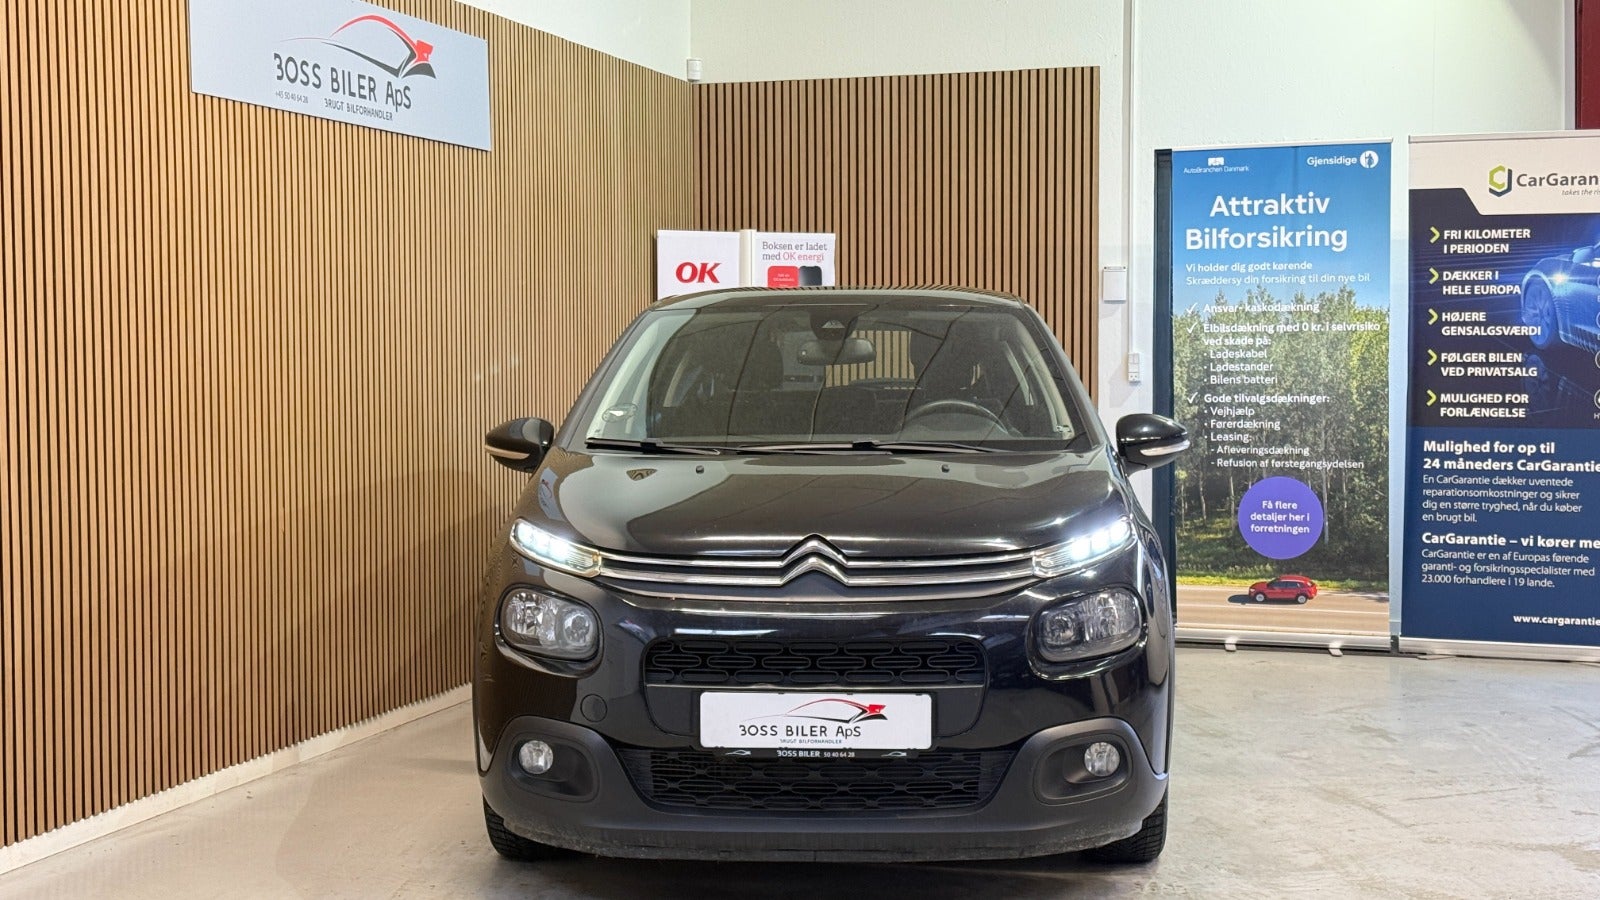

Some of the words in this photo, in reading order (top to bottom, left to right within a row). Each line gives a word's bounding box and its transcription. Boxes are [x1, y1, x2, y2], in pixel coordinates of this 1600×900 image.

[331, 67, 376, 102] BILER
[386, 81, 411, 112] ApS
[346, 102, 393, 120] BILFORHANDLER
[1307, 156, 1357, 167] Gjensidige
[1517, 173, 1600, 187] CarGaran
[1210, 191, 1330, 217] Attraktiv
[1186, 224, 1347, 252] Bilforsikring
[1443, 230, 1461, 240] FRI
[1464, 229, 1531, 239] KILOMETER
[762, 241, 793, 250] Boksen
[806, 243, 827, 251] ladet
[1444, 245, 1447, 254] I
[1450, 244, 1509, 253] PERIODEN
[762, 252, 781, 261] med
[783, 253, 796, 261] OK
[797, 253, 824, 263] energi
[675, 261, 721, 284] OK
[1186, 263, 1195, 271] Vi
[1198, 263, 1228, 271] holder
[1231, 262, 1246, 273] dig
[1248, 262, 1270, 272] godt
[1272, 261, 1312, 270] kørende
[1186, 276, 1242, 286] Skræddersy
[1244, 275, 1258, 284] din
[1261, 274, 1306, 285] forsikring
[1308, 275, 1318, 283] til
[1321, 274, 1335, 282] din
[1338, 275, 1355, 284] nye
[1358, 273, 1370, 282] bil
[1443, 271, 1492, 280] DÆKKER
[1495, 271, 1499, 280] I
[1443, 285, 1471, 295] HELE
[1474, 285, 1521, 295] EUROPA
[1245, 303, 1319, 314] kaskodækning
[1442, 312, 1486, 321] HØJERE
[1203, 323, 1274, 334] Elbilsdækning
[1277, 323, 1299, 332] med
[1302, 323, 1309, 331] 0
[1311, 323, 1324, 331] kr.
[1332, 322, 1380, 331] selvrisiko
[1441, 326, 1541, 336] GENSALGSVÆRDI
[1203, 338, 1222, 346] ved
[1224, 337, 1253, 345] skade
[1256, 336, 1271, 348] på:
[1210, 350, 1267, 358] Ladeskabel
[1441, 353, 1486, 362] FØLGER
[1488, 353, 1522, 362] BILEN
[1210, 363, 1273, 371] Ladestander
[1441, 367, 1465, 376] VED
[1467, 367, 1538, 376] PRIVATSALG
[1210, 375, 1241, 384] Bilens
[1244, 376, 1278, 384] batteri
[1204, 394, 1231, 403] Gode
[1234, 394, 1329, 404] tilvalgsdækninger:
[1440, 394, 1503, 403] MULIGHED
[1505, 394, 1529, 403] FOR
[1210, 407, 1255, 417] Vejhjælp
[1440, 408, 1526, 418] FORLÆNGELSE
[1210, 420, 1280, 430] Førerdækning
[1216, 446, 1310, 456] Afleveringsdækning
[1423, 440, 1490, 455] Mulighed
[1494, 442, 1514, 453] for
[1517, 444, 1537, 456] op
[1539, 442, 1555, 454] til
[1216, 459, 1257, 468] Refusion
[1260, 459, 1269, 468] af
[1271, 460, 1364, 470] førstegangsydelsen
[1423, 458, 1440, 469] 24
[1444, 458, 1514, 471] måneders
[1423, 475, 1434, 484] En
[1436, 475, 1490, 485] CarGarantie
[1492, 476, 1526, 486] dækker
[1528, 477, 1573, 487] uventede
[1423, 488, 1538, 500] reparationsomkostninger
[1539, 492, 1553, 500] og
[1554, 491, 1580, 500] sikrer
[1262, 500, 1273, 509] Få
[1275, 501, 1297, 509] flere
[1422, 501, 1437, 510] dig
[1453, 501, 1480, 510] større
[1482, 501, 1521, 512] tryghed,
[1522, 502, 1538, 511] når
[1539, 503, 1553, 512] du
[1554, 503, 1583, 512] køber
[1250, 512, 1287, 522] detaljer
[1289, 513, 1305, 521] her
[1436, 513, 1462, 524] brugt
[1463, 513, 1477, 523] bil.
[1250, 524, 1310, 535] forretningen
[1422, 533, 1507, 546] CarGarantie
[1521, 535, 1534, 546] vi
[1537, 536, 1576, 548] kører
[1421, 549, 1475, 559] CarGarantie
[1502, 551, 1512, 560] af
[1513, 552, 1550, 563] Europas
[1552, 553, 1589, 563] førende
[1421, 563, 1457, 573] garanti-
[1459, 565, 1471, 573] og
[1473, 563, 1571, 576] forsikringsspecialister
[1573, 567, 1595, 576] med
[1421, 574, 1452, 584] 23.000
[1453, 575, 1506, 586] forhandlere
[1514, 577, 1525, 586] 19
[1526, 577, 1555, 587] lande.
[785, 725, 827, 737] BILER
[835, 725, 861, 739] ApS
